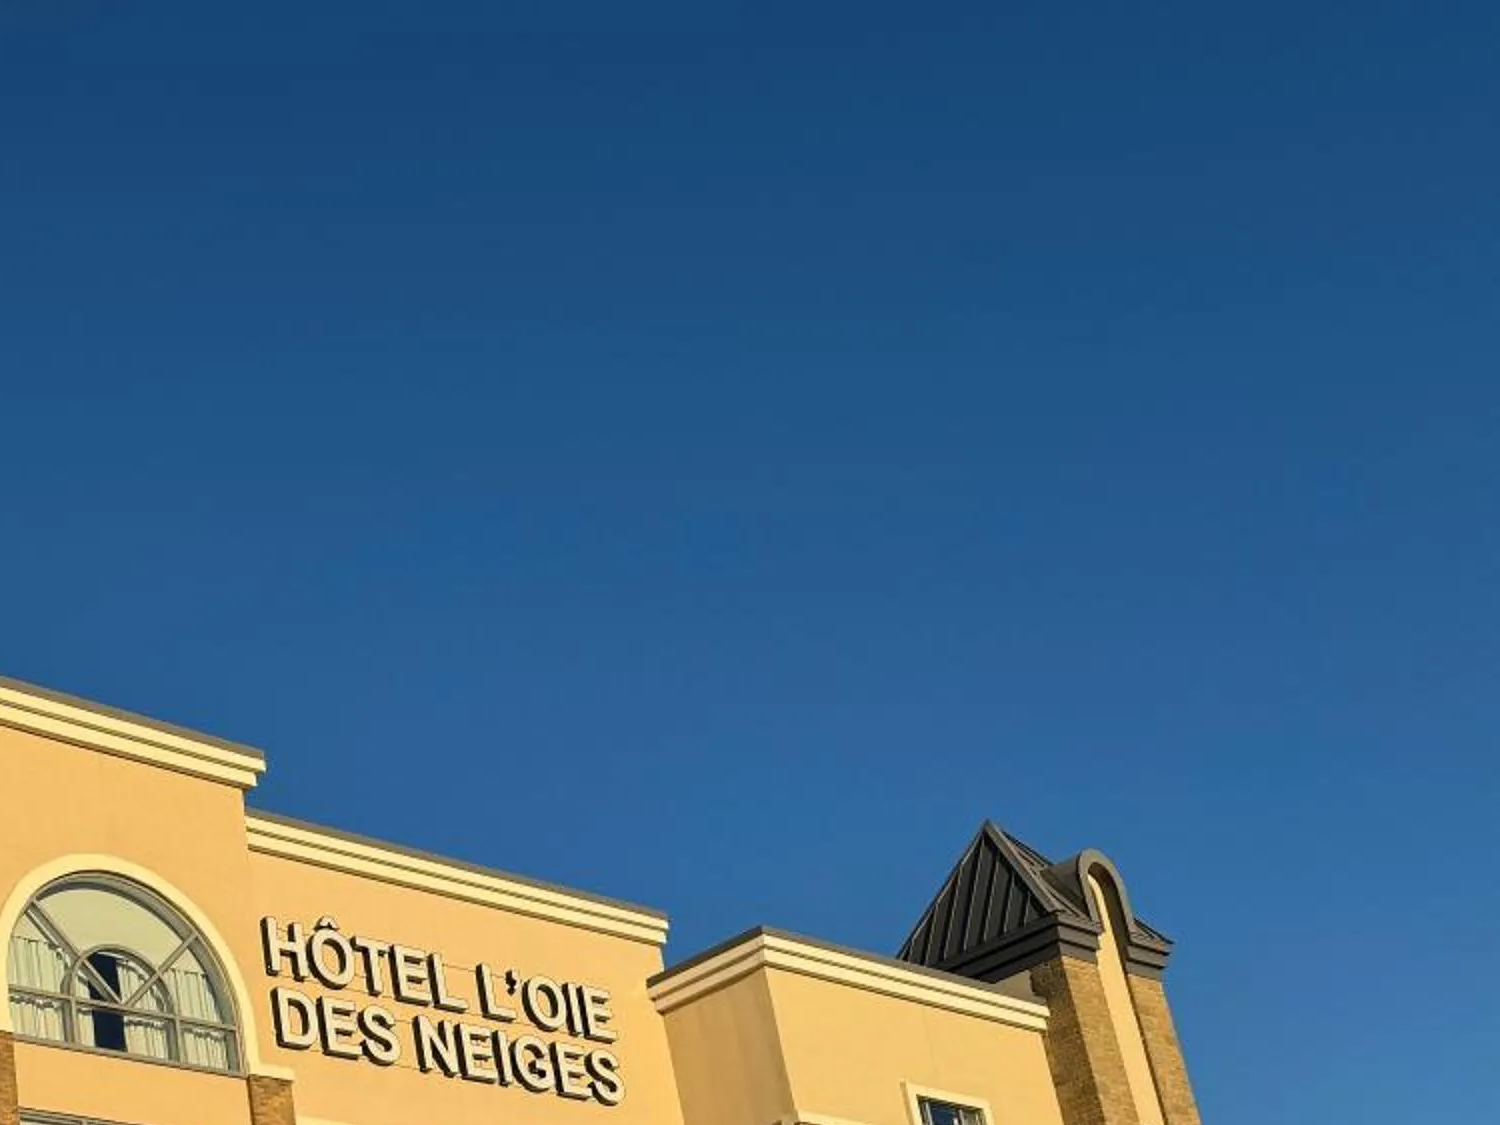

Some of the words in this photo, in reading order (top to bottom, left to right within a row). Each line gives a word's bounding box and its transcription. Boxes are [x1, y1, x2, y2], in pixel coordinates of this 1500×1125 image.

[261, 915, 467, 1013] HÔTEL
[476, 963, 618, 1043] L'OIE
[271, 987, 401, 1066] DES
[413, 1015, 626, 1106] NEIGES
